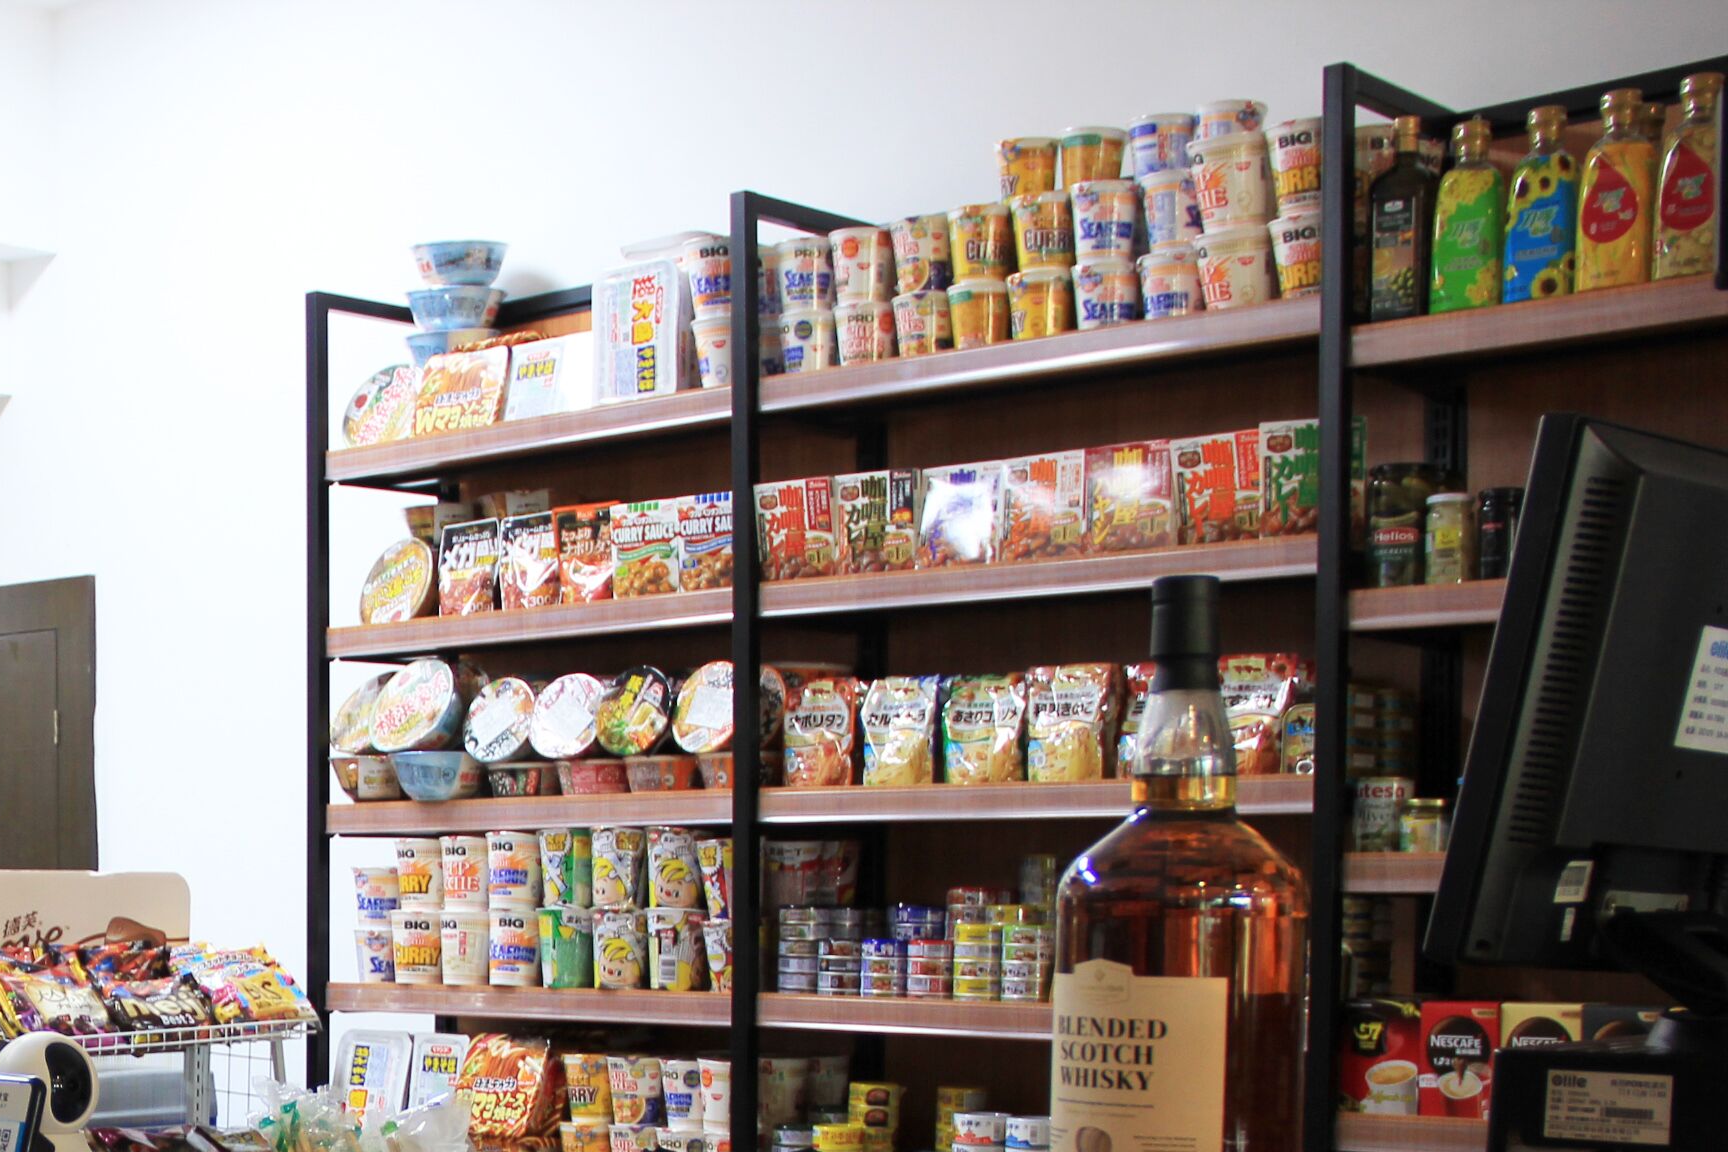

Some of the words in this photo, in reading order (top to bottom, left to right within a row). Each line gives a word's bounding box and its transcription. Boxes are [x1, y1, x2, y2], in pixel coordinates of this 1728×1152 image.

[847, 314, 874, 324] PRO
[679, 518, 712, 537] CURRY
[712, 516, 733, 534] SAU
[612, 526, 640, 545] CURRY
[953, 708, 1018, 723] あさりコソメ
[444, 845, 467, 856] BIG
[492, 842, 513, 852] BIG
[403, 920, 430, 930] BIG
[499, 918, 524, 929] BIG
[1057, 1015, 1168, 1041] BLENDED
[1060, 1041, 1154, 1066] SCOTCH
[1060, 1065, 1154, 1091] WHISKY
[569, 1087, 598, 1104] RRY
